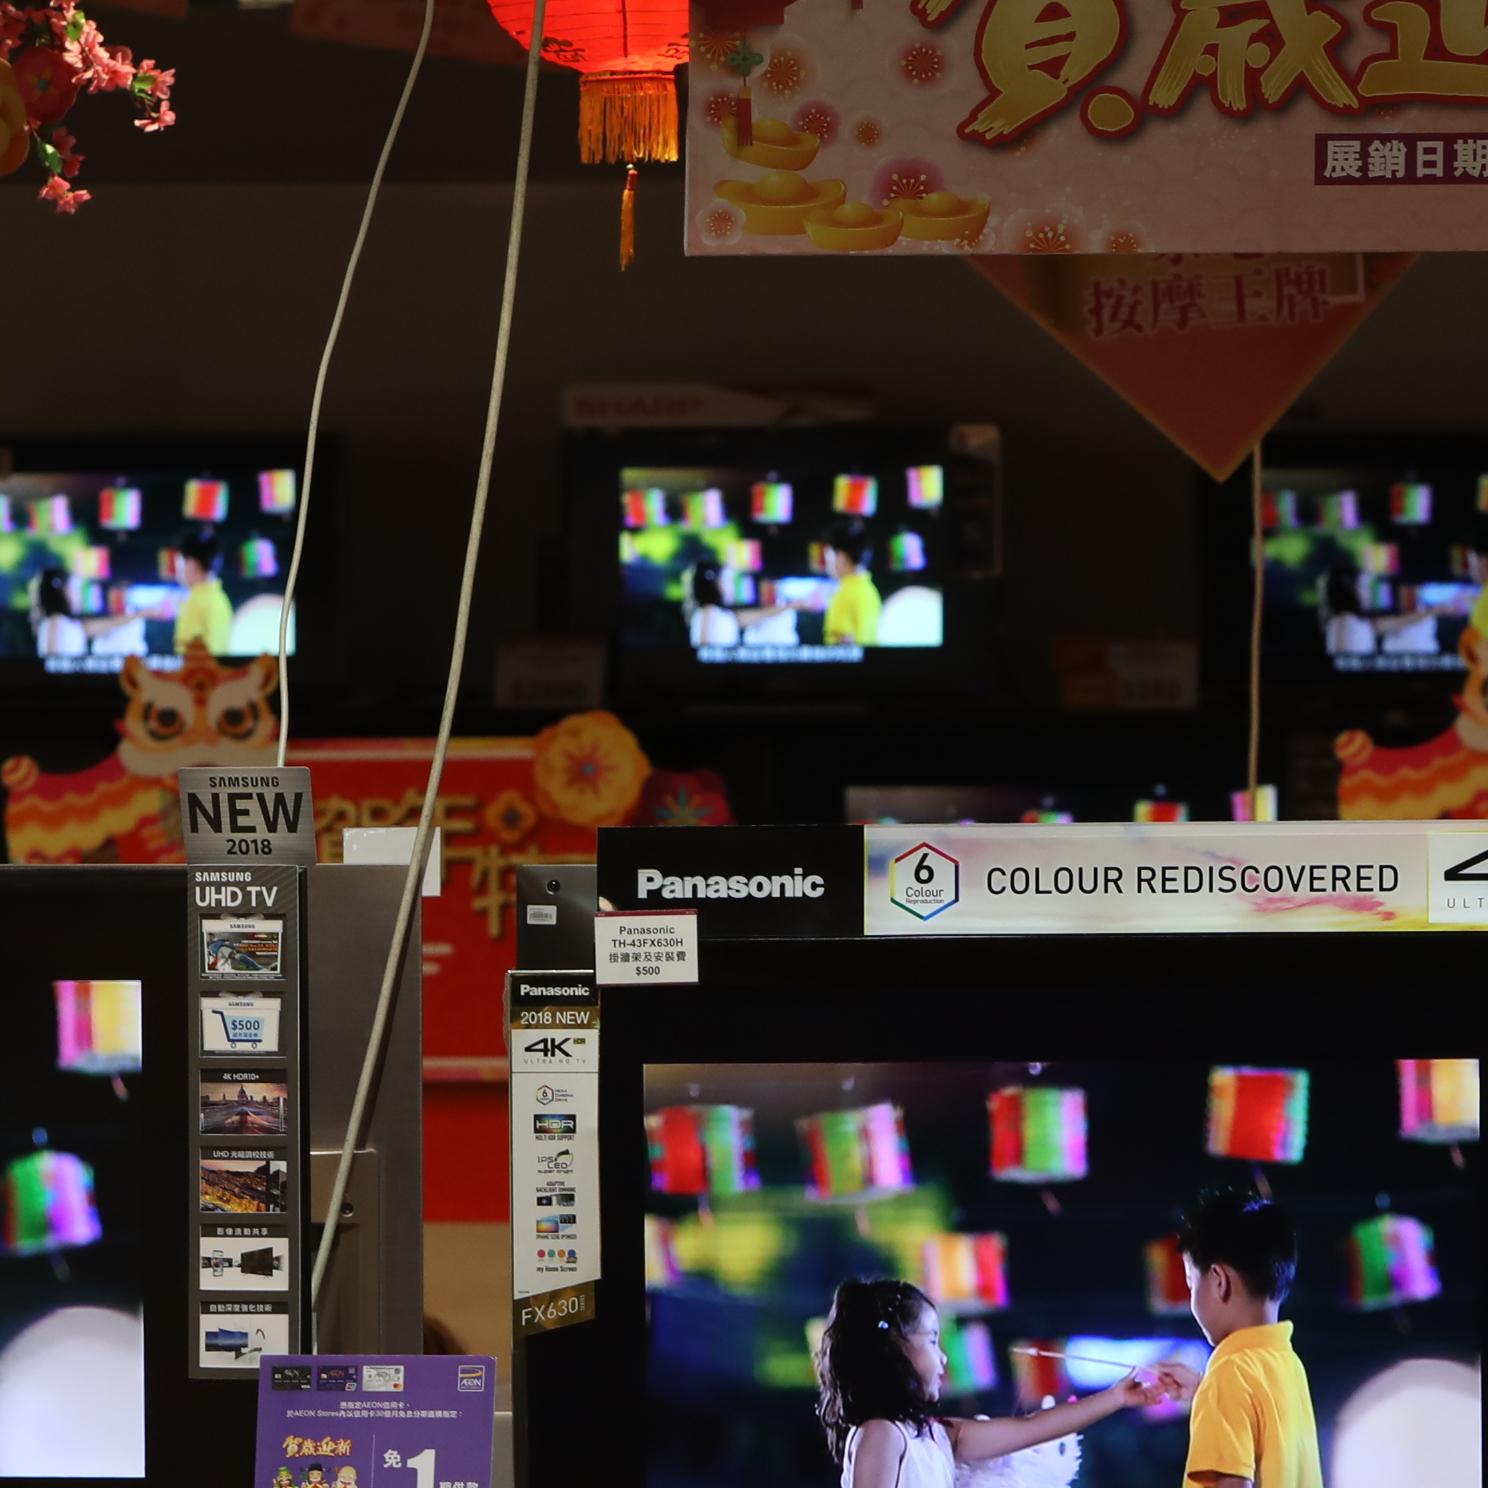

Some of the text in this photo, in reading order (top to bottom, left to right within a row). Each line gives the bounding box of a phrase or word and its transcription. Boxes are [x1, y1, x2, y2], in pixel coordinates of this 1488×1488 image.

[1085, 265, 1330, 339] 按摩王牌
[209, 776, 280, 788] SAMSUNG
[188, 791, 304, 834] NEW
[226, 838, 273, 857] 2018
[195, 872, 252, 882] SAMSUNG
[914, 853, 935, 884] 6
[638, 868, 825, 898] Panasonic
[987, 862, 1399, 896] COLOUR REDISCOVERED
[195, 886, 278, 907] UHD TV
[905, 886, 944, 898] Colour
[618, 925, 676, 936] Panasonic
[611, 937, 684, 949] TH-43FX630H
[635, 965, 661, 977] $500
[520, 984, 590, 996] Panasonic
[231, 1020, 260, 1031] $500
[520, 1011, 590, 1025] 2018 NEW
[524, 1037, 573, 1057] 4K
[536, 1120, 574, 1129] HDR
[521, 1297, 579, 1326] FX630
[282, 1434, 352, 1458] 賀歲迎新
[383, 1450, 402, 1468] 免
